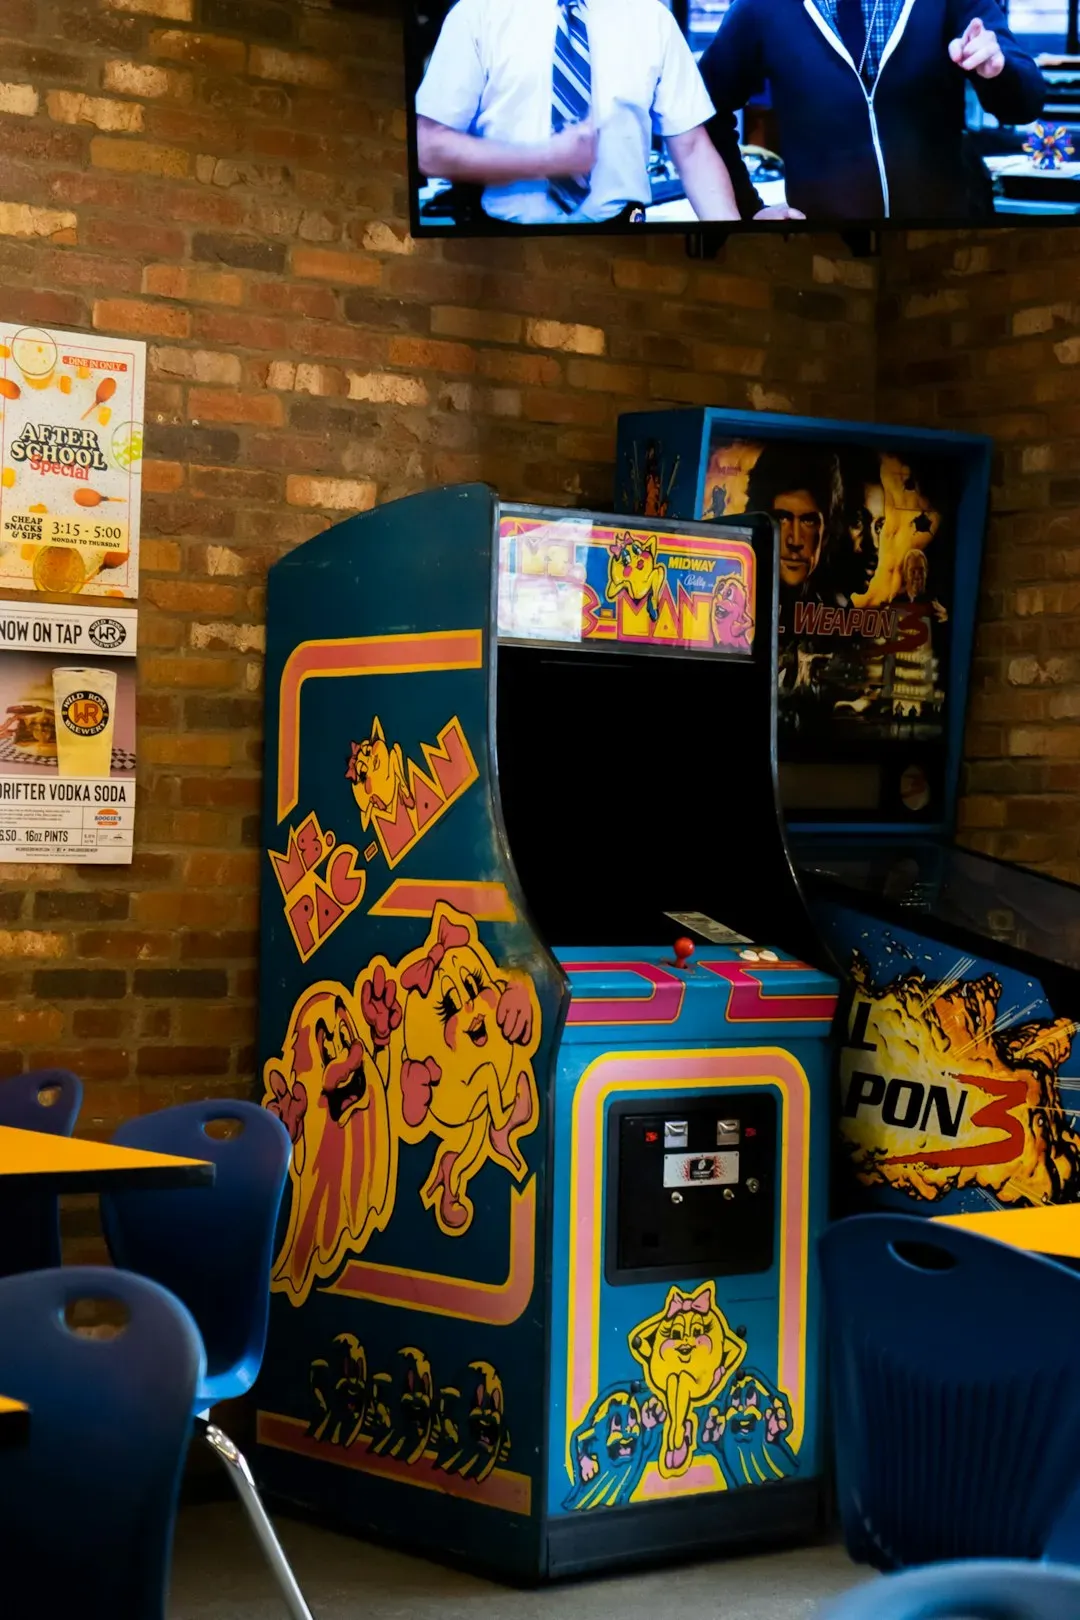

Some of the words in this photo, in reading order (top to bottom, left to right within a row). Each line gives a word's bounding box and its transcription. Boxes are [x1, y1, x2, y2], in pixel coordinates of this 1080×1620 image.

[68, 357, 88, 367] DINE
[89, 360, 99, 369] IN
[100, 361, 122, 371] ONLY
[20, 422, 99, 449] AFTER
[11, 440, 108, 471] SCHOOL
[30, 454, 89, 480] Special
[4, 522, 42, 533] SNACKS
[11, 515, 43, 525] CHEAP
[11, 531, 19, 539] &
[21, 531, 42, 541] SIPS
[52, 522, 80, 537] 3:15
[94, 526, 121, 540] 5:00
[51, 537, 77, 545] MONDAY
[88, 540, 120, 548] THURSDAY
[668, 556, 716, 573] MIDWAY
[684, 574, 706, 590] Bally
[794, 601, 897, 638] WEAPON
[0, 620, 29, 642] NOW
[33, 622, 52, 643] ON
[56, 624, 82, 645] TAP
[99, 626, 116, 641] WR
[64, 693, 84, 708] WILD
[74, 703, 98, 724] WR
[65, 719, 105, 735] BREWERY
[49, 784, 91, 802] VODKA
[94, 785, 126, 802] SODA
[44, 830, 69, 843] PINTS
